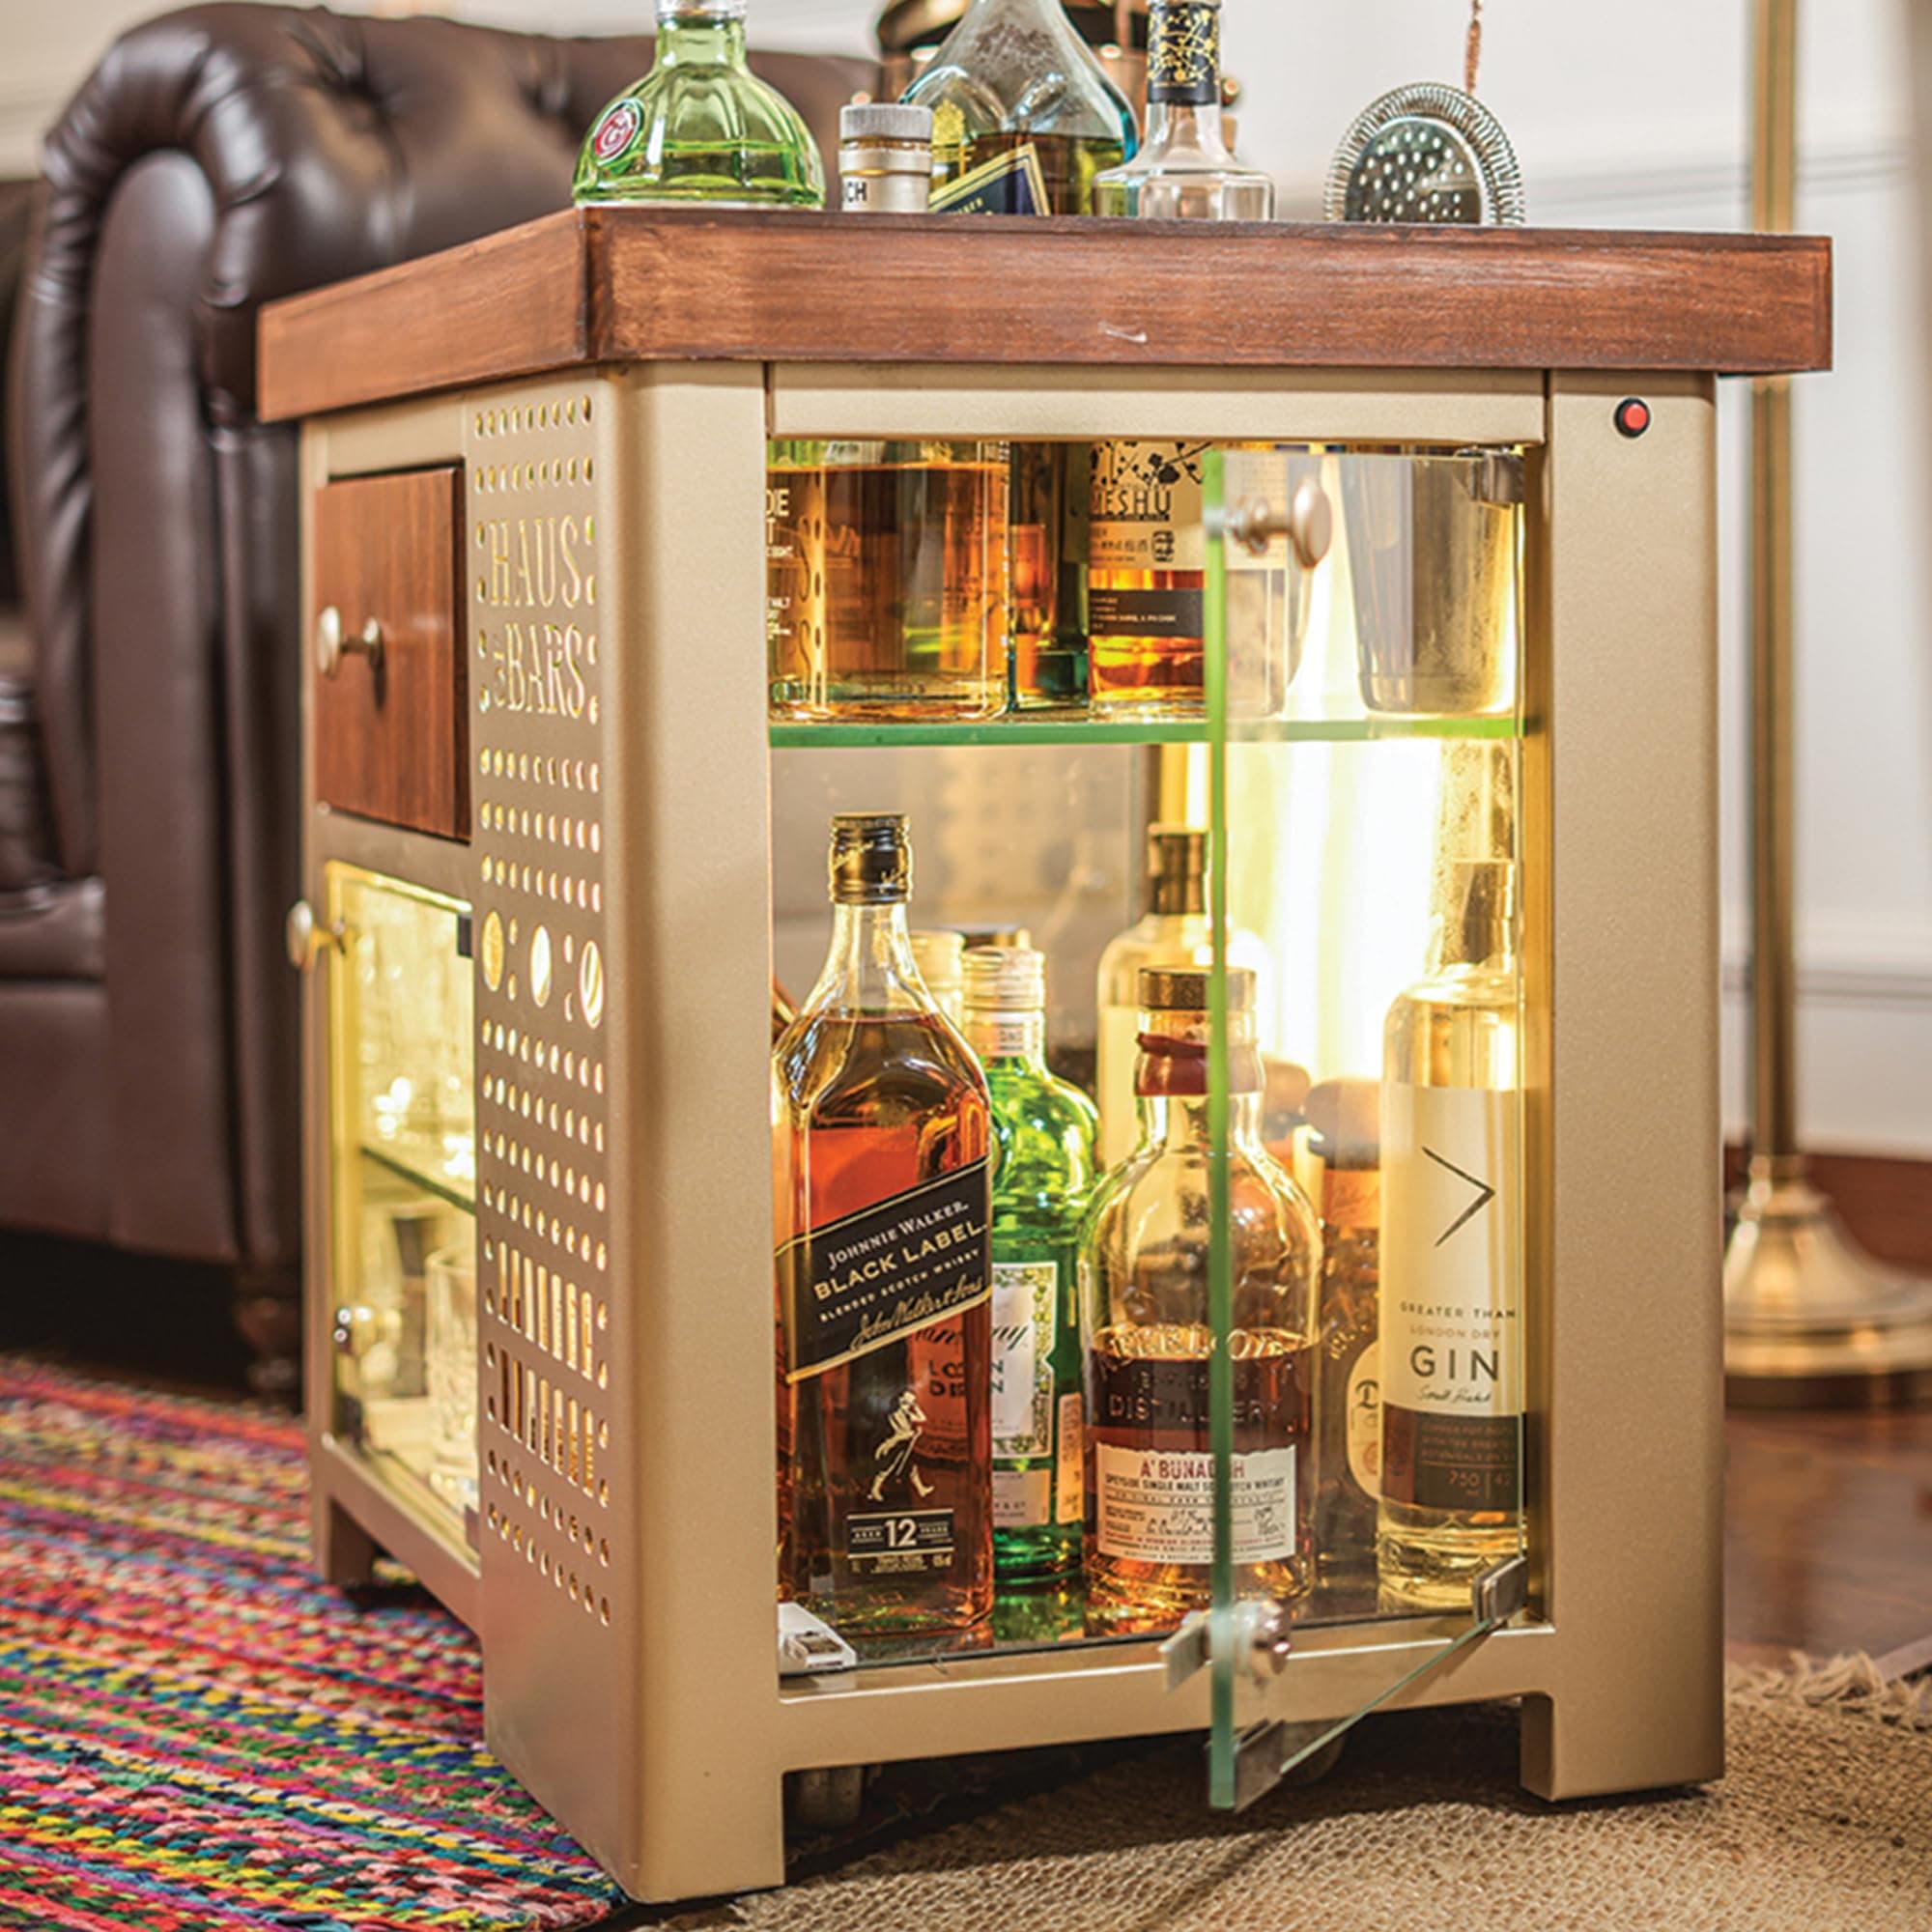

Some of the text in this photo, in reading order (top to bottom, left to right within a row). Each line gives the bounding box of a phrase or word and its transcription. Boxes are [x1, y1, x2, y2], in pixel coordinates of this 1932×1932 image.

[489, 515, 581, 609] HAUS
[504, 622, 584, 719] BARS
[813, 1253, 898, 1300] BLACK
[1400, 1301, 1516, 1319] GREATER THAN
[1409, 1324, 1500, 1340] LONDON DRY
[1409, 1346, 1499, 1381] GIN
[1176, 1481, 1201, 1492] MALT
[884, 1518, 918, 1548] 12
